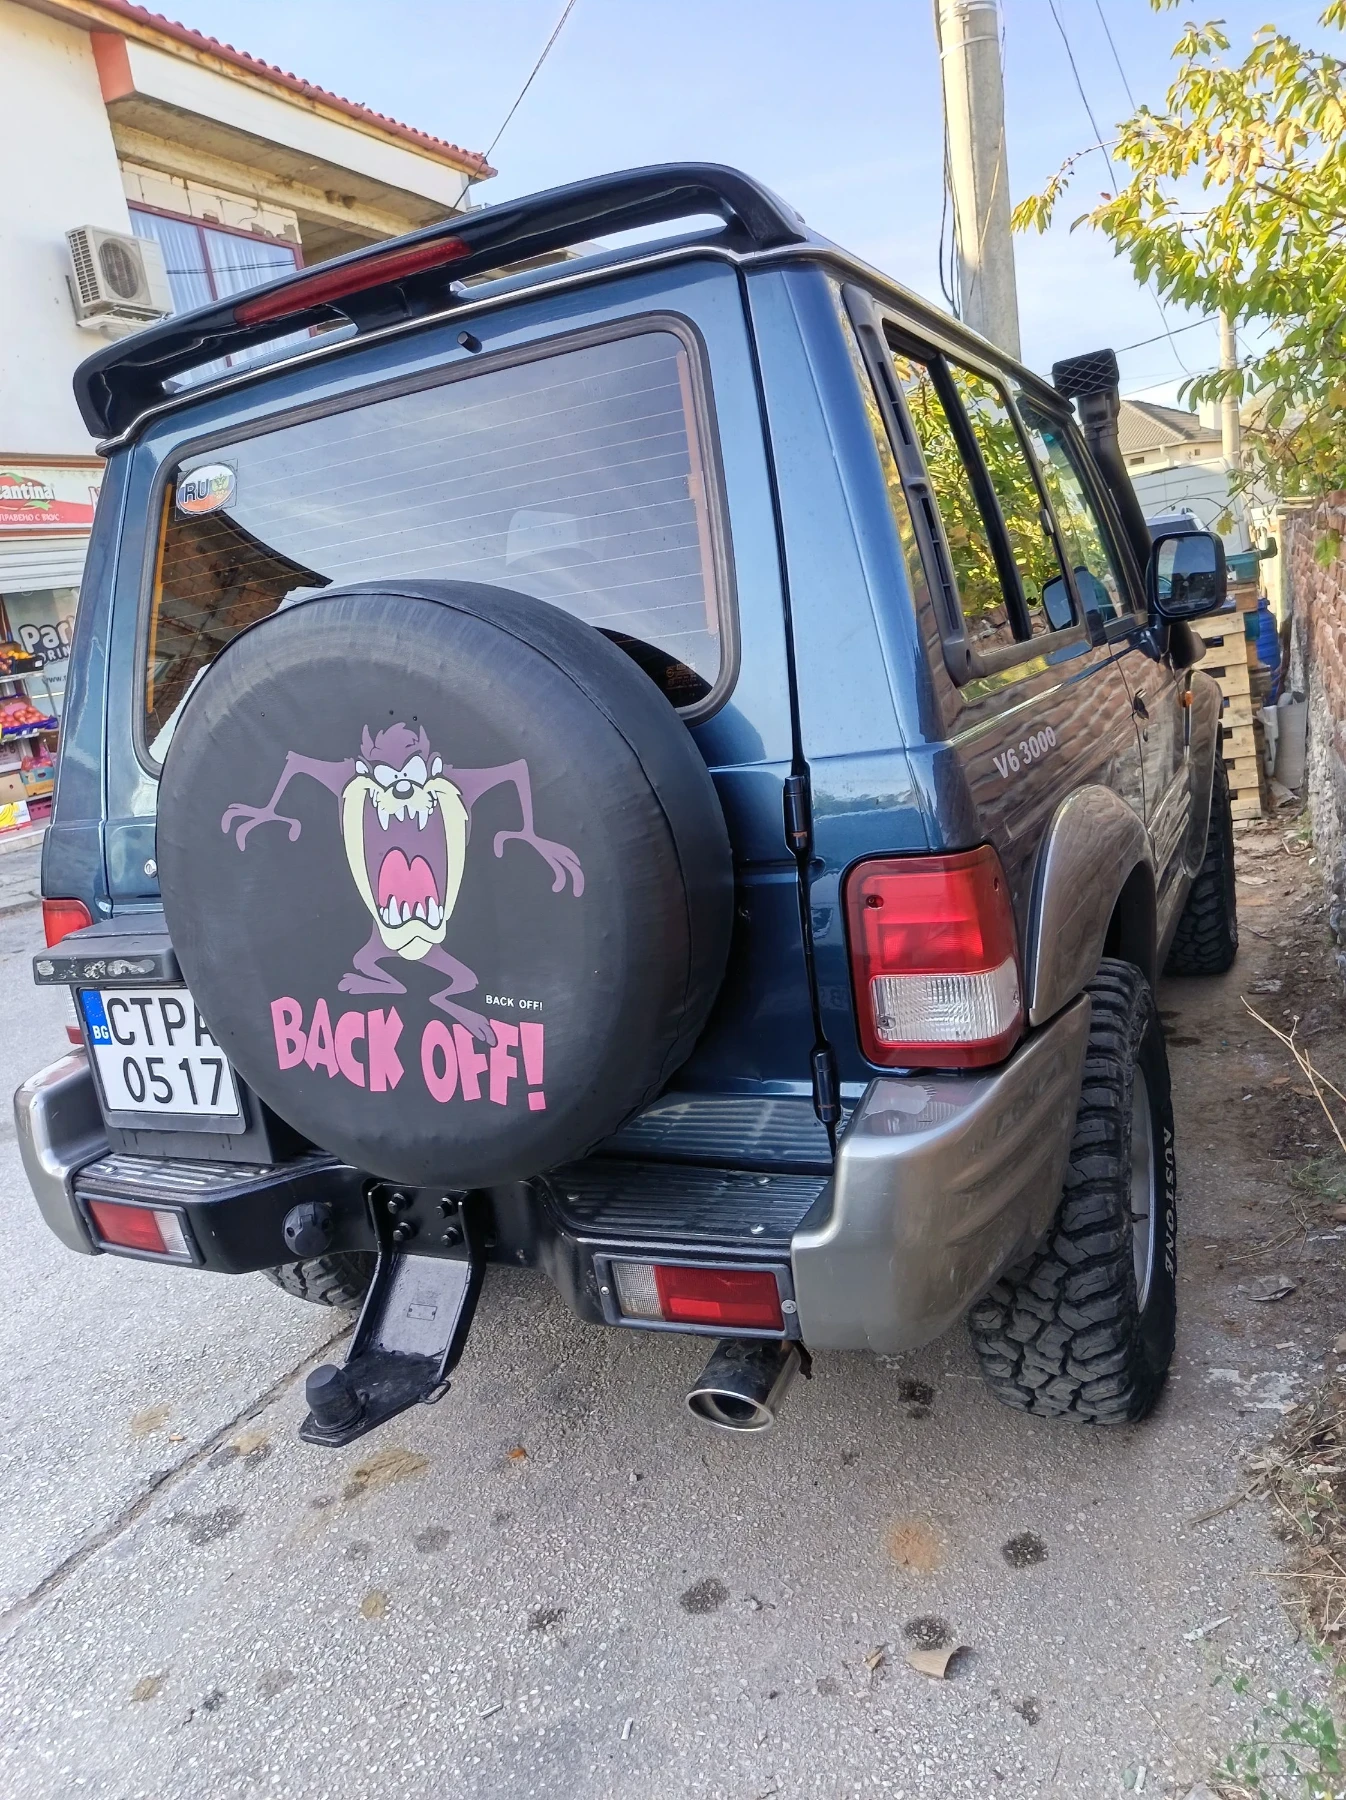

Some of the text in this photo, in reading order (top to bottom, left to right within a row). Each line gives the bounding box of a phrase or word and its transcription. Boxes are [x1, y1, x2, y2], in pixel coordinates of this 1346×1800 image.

[184, 479, 209, 502] RU
[19, 614, 75, 655] Par
[992, 726, 1057, 778] V6 3000
[485, 994, 543, 1010] BACK OFF!
[92, 1025, 109, 1040] BG
[270, 996, 546, 1111] BACK OFF!
[123, 1056, 223, 1106] 0517
[1163, 1127, 1176, 1279] AUSTONE
